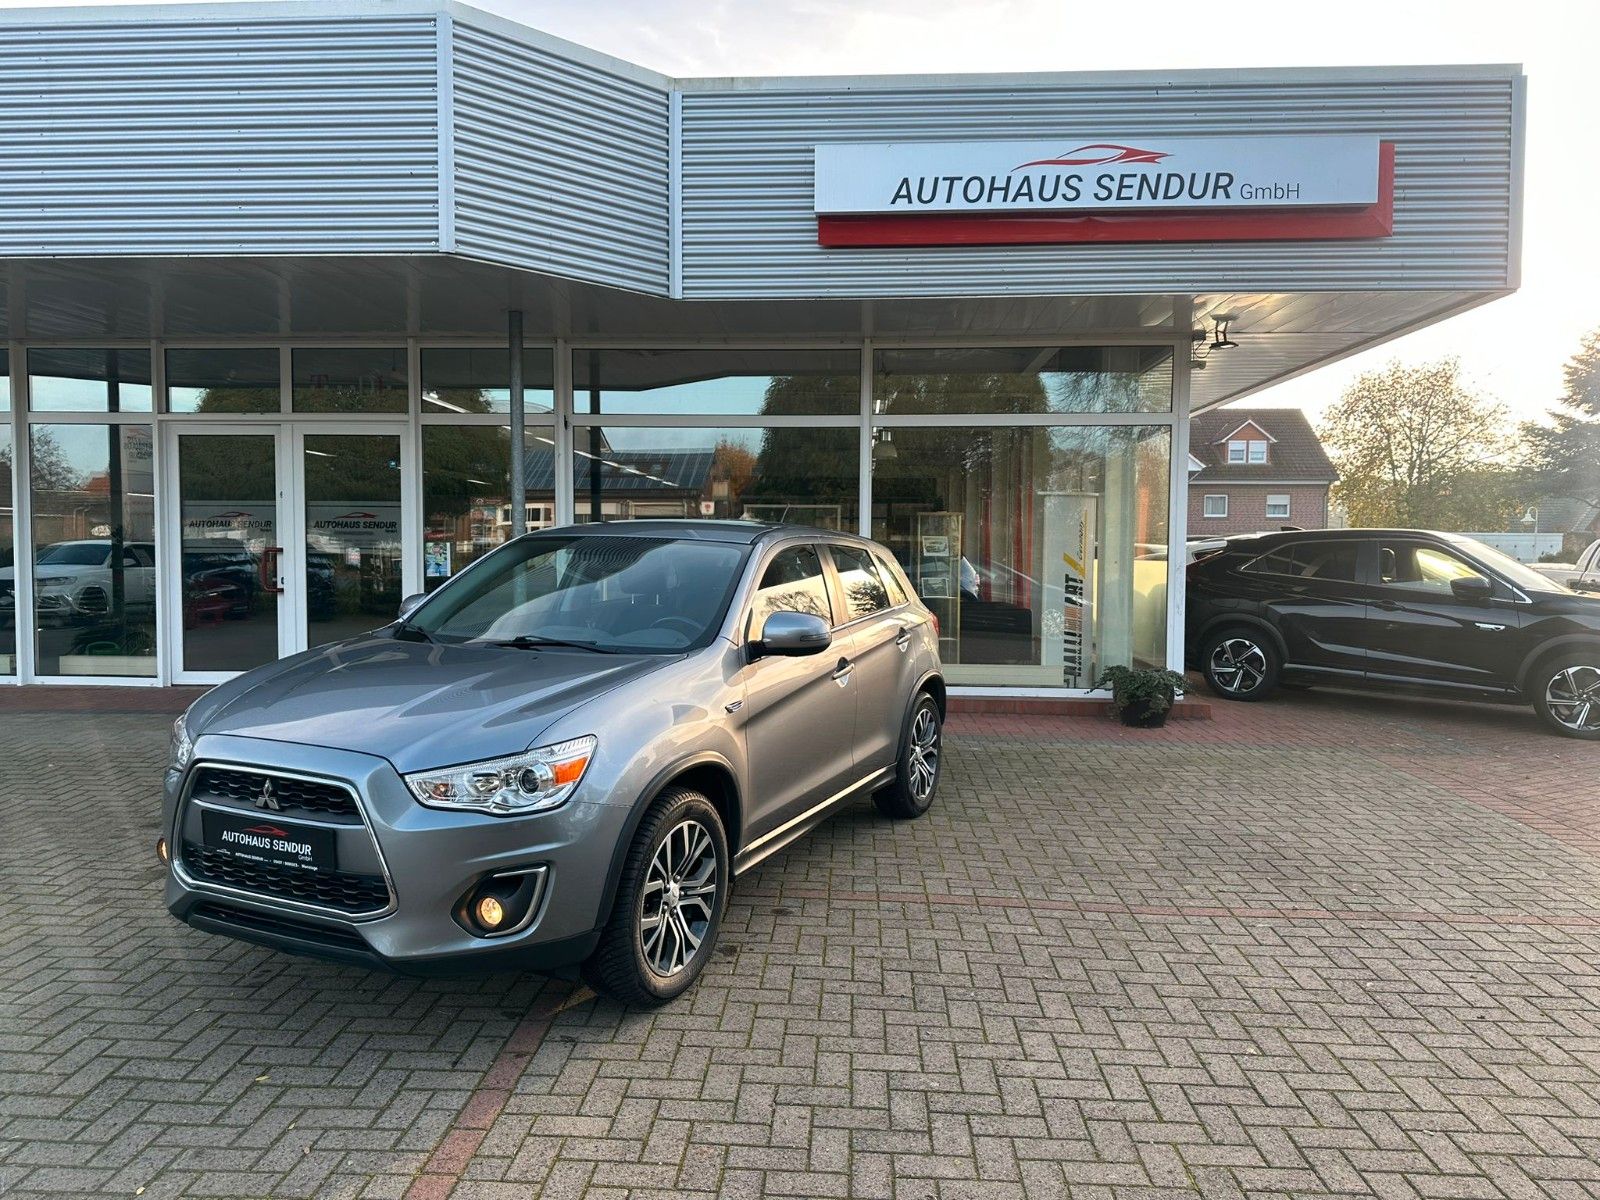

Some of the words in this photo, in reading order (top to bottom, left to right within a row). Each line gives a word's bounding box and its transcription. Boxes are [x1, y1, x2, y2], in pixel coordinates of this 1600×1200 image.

[891, 174, 1083, 205] AUTOHAUS
[1093, 171, 1234, 201] SENDUR
[1240, 182, 1300, 200] GmbH
[314, 521, 361, 529] AUTOHAUS
[362, 521, 397, 529] SENDUR
[222, 830, 271, 848] AUTOHAUS
[272, 839, 312, 855] SENDUR
[298, 854, 313, 862] GmbH
